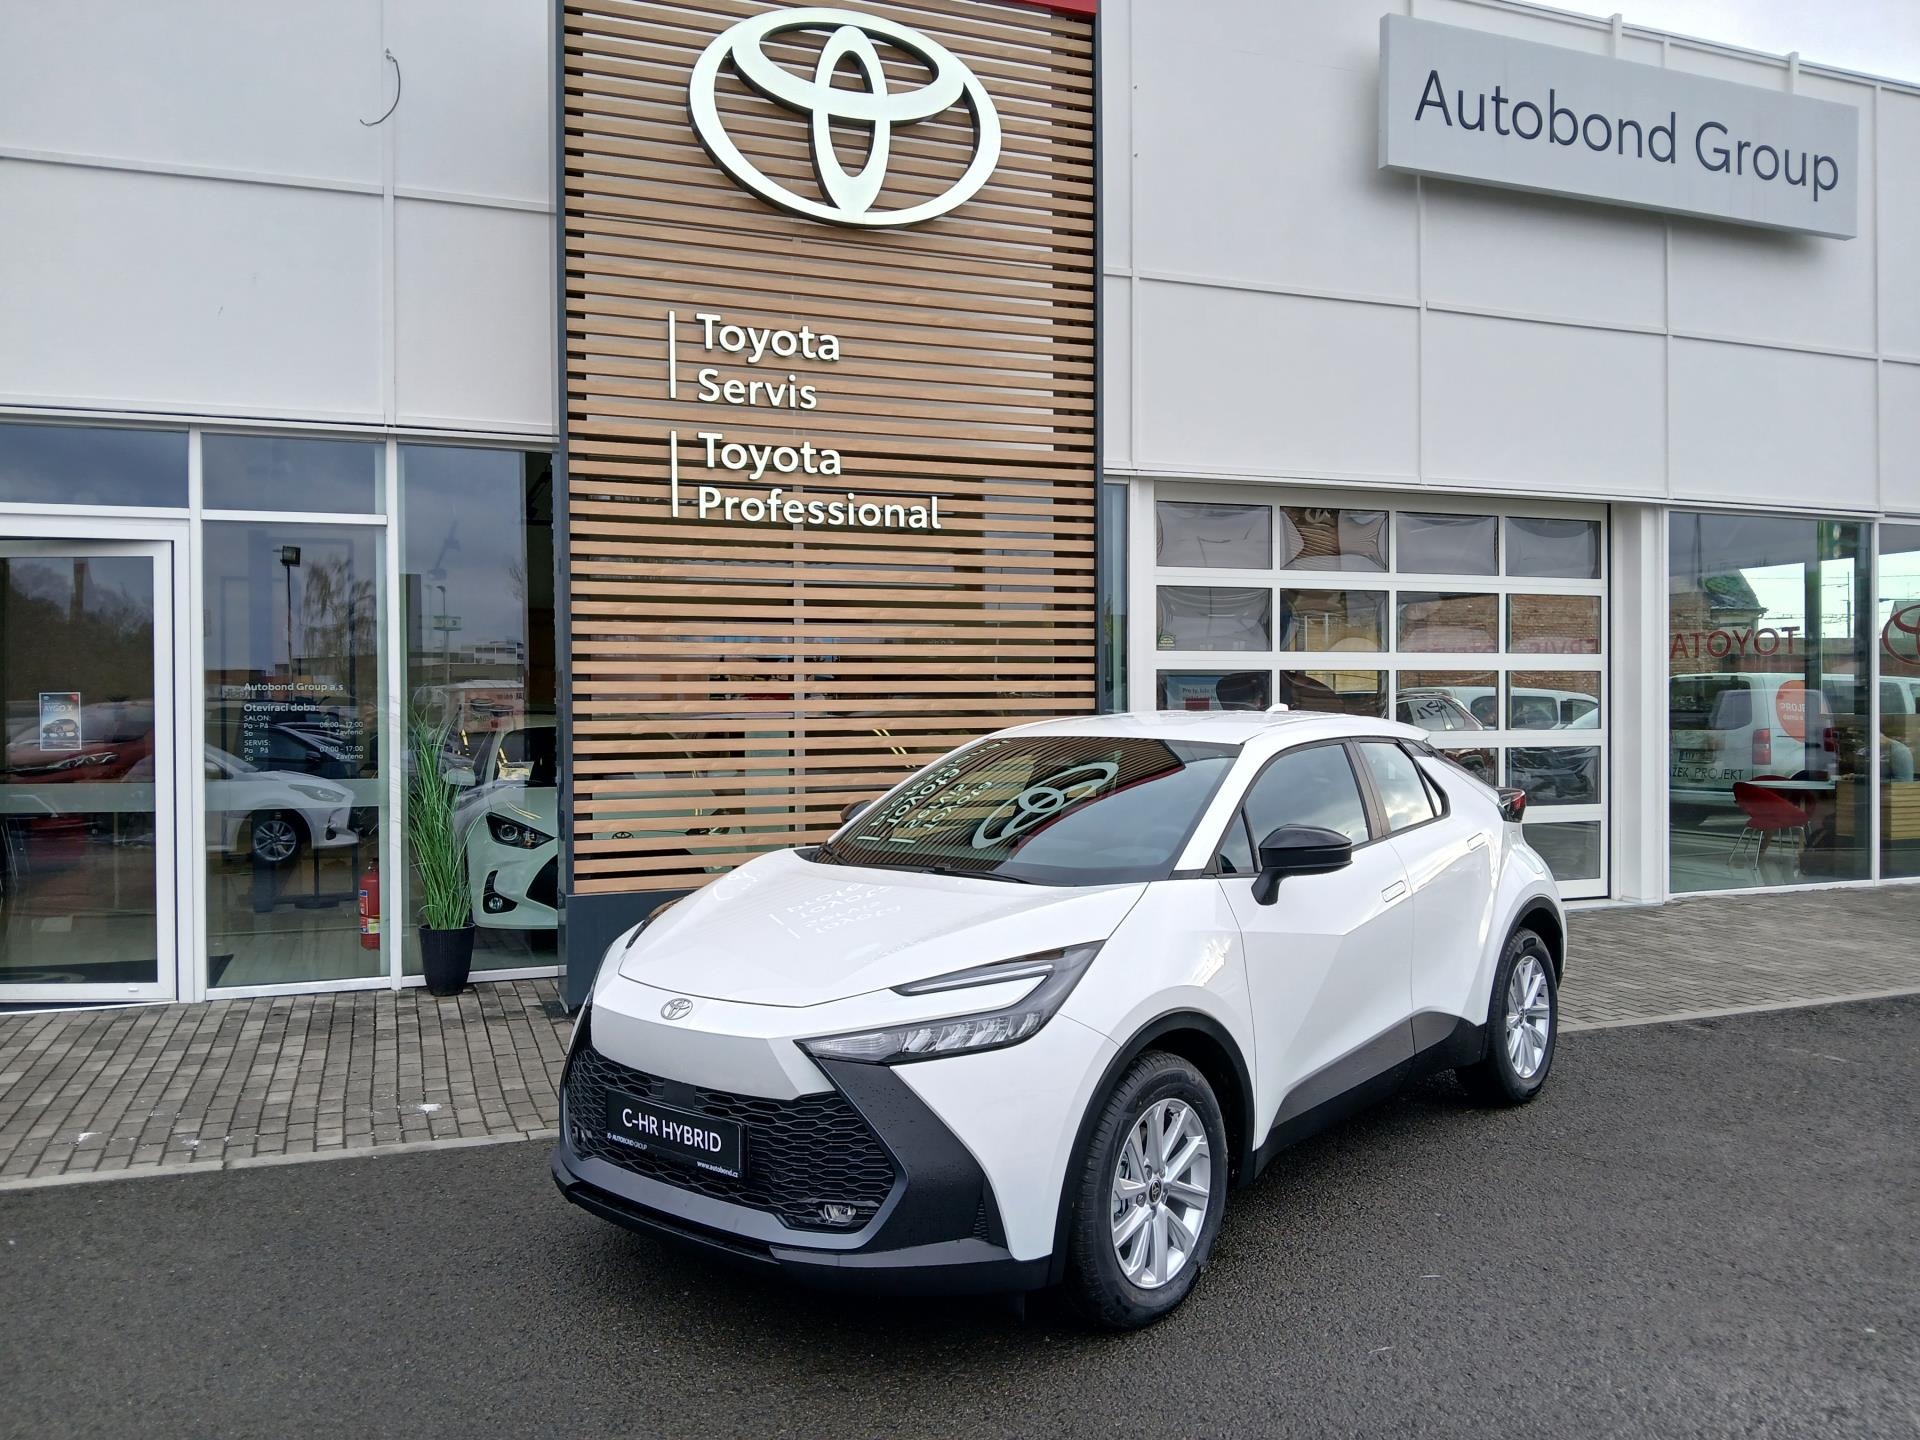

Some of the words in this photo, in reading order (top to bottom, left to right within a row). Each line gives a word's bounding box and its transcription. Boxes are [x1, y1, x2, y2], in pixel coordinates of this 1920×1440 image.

[1414, 69, 1677, 165] Autobond
[1695, 120, 1840, 203] Group
[695, 312, 841, 365] Toyota
[697, 367, 818, 411] Servis
[697, 431, 843, 481] Toyota
[698, 485, 943, 530] Professional
[243, 682, 294, 691] Autobond
[296, 682, 328, 694] Group
[290, 703, 320, 712] doba:
[1694, 767, 1745, 781] PROJEKT
[622, 1108, 659, 1137] C-HR
[662, 1119, 722, 1153] HYBRID
